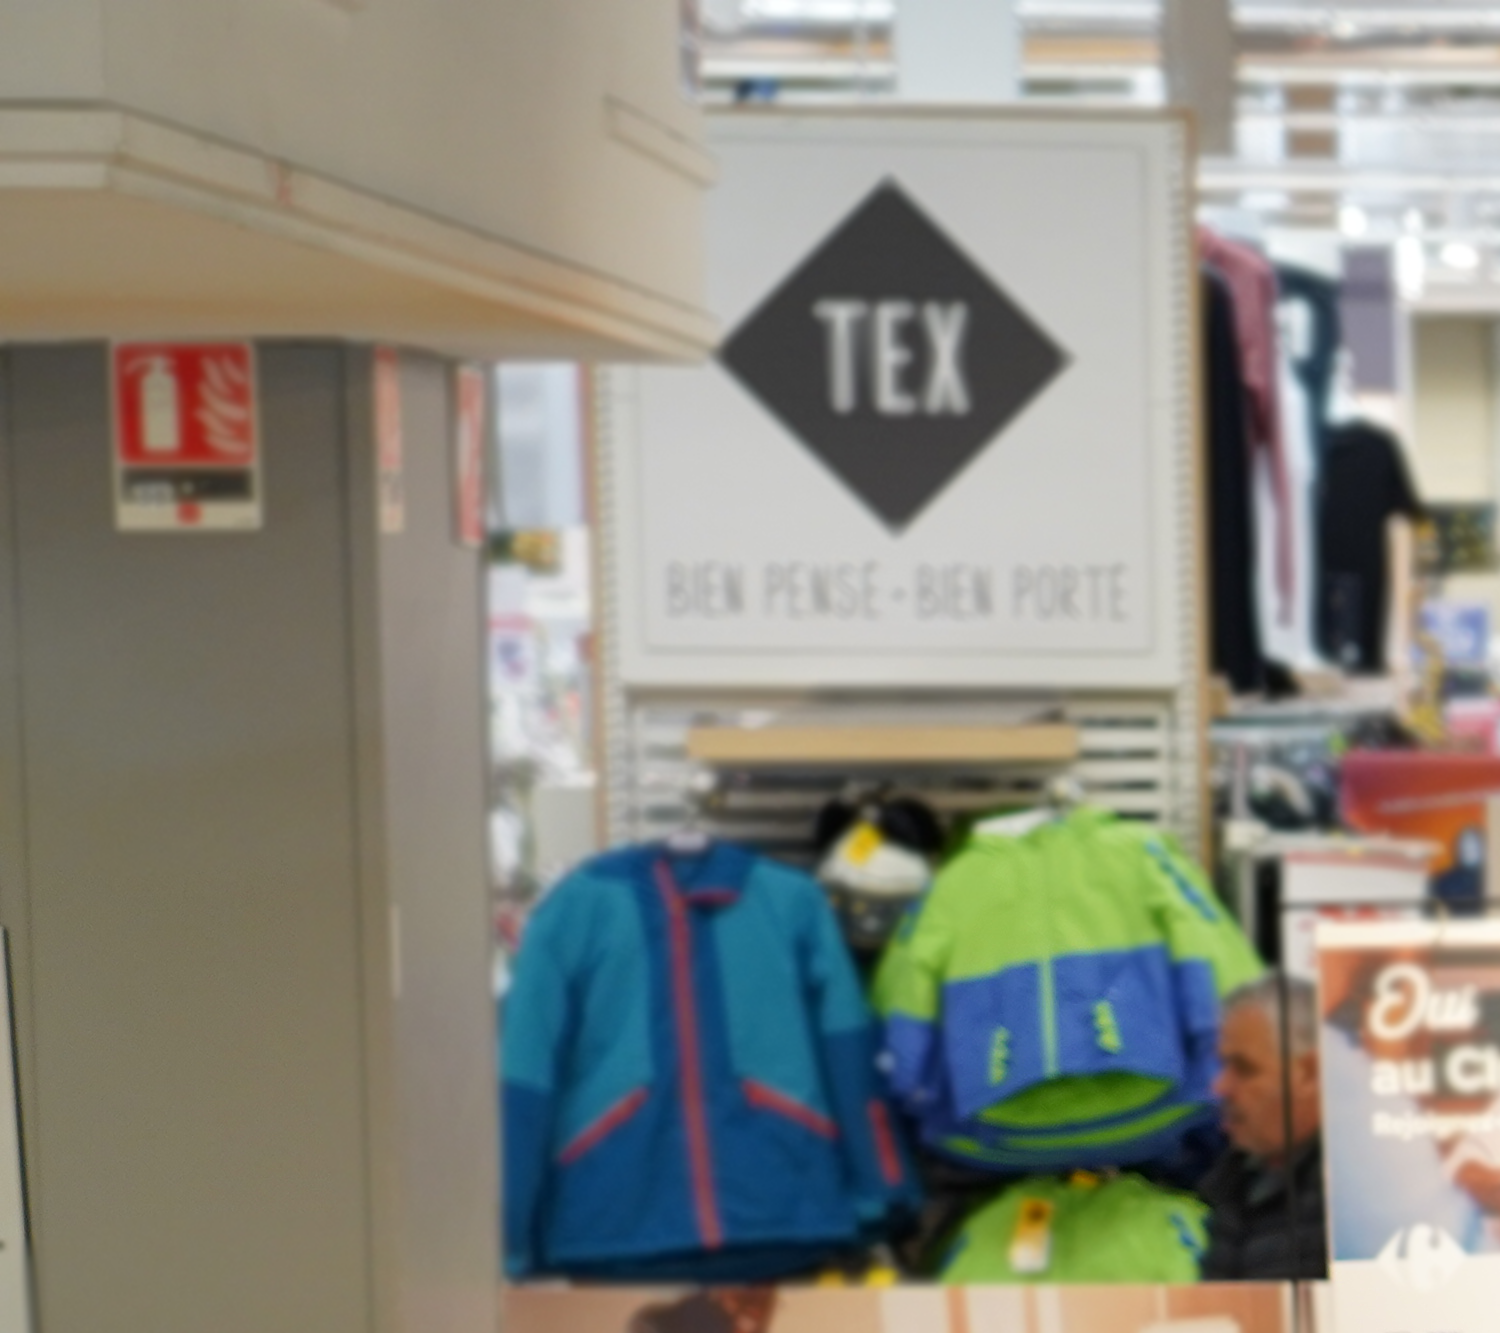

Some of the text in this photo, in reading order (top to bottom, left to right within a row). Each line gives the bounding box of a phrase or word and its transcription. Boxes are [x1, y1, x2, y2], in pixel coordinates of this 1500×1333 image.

[815, 301, 970, 414] TEX
[664, 558, 993, 621] BIEN BIEN
[1371, 1059, 1434, 1096] au
